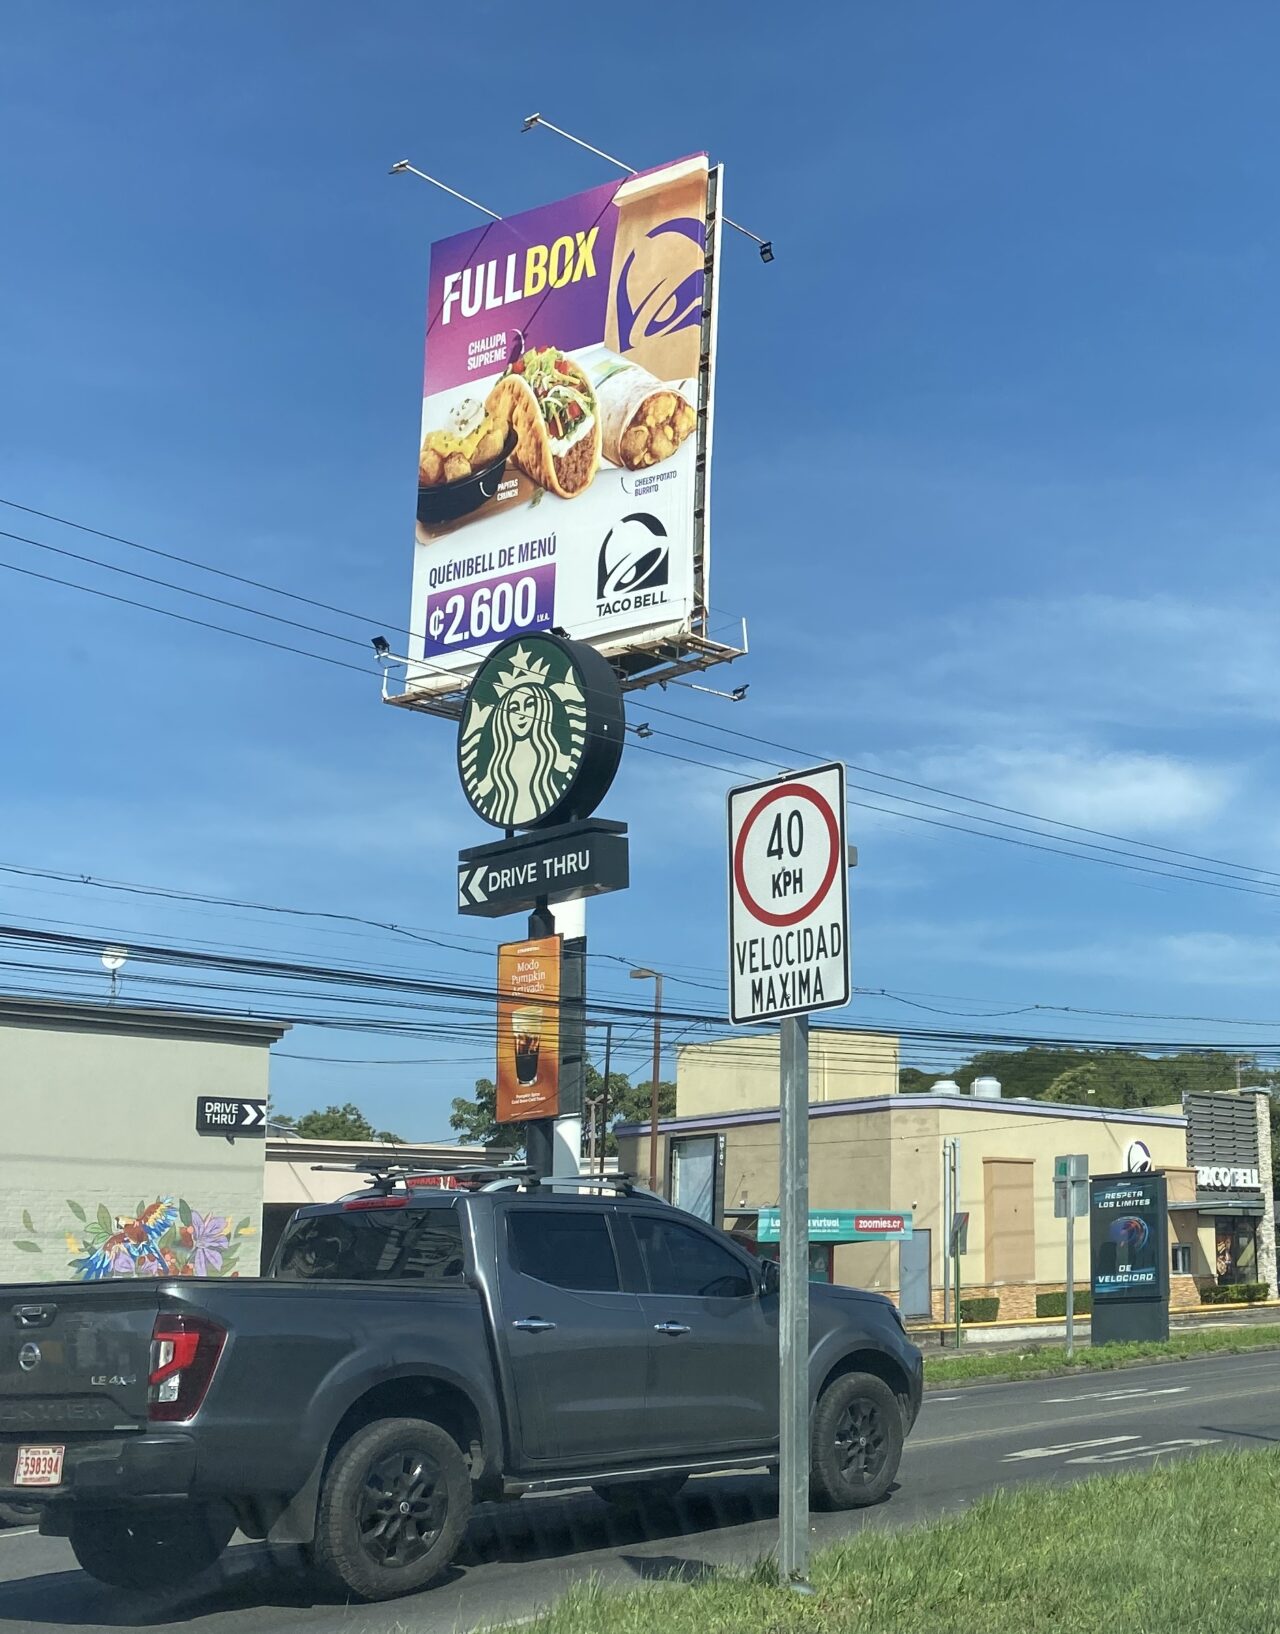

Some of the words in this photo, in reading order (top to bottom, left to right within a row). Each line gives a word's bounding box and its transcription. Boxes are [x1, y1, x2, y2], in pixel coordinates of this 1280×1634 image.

[468, 332, 506, 356] CHALUPA
[467, 347, 507, 371] SUPREME
[635, 475, 656, 488] CHEESY
[656, 470, 677, 482] POTATO
[634, 483, 659, 497] BURRITO
[429, 550, 495, 588] QUÉNIBELL
[498, 546, 515, 568] DE
[517, 532, 557, 563] MENÚ
[596, 596, 632, 618] TACO
[633, 590, 668, 610] BELL
[766, 809, 804, 860] 40
[488, 862, 537, 892] DRIVE
[543, 850, 591, 879] THRU
[771, 868, 803, 899] KPH
[736, 922, 841, 976] VELOCIDAD
[517, 958, 540, 973] Modo
[511, 970, 546, 986] Pumpkin
[751, 966, 825, 1014] MAXIMA
[205, 1102, 239, 1114] DRIVE
[204, 1113, 236, 1125] THRU
[1196, 1166, 1231, 1187] TACO
[1230, 1168, 1261, 1188] BELL
[1104, 1190, 1143, 1200] RESPETA
[1098, 1201, 1115, 1209] LOS
[812, 1216, 840, 1227] virtual
[858, 1218, 901, 1229] zoomies.cr
[1118, 1264, 1132, 1273] DE
[1098, 1273, 1154, 1283] VELOCIDAD
[91, 1375, 107, 1386] LE
[23, 1456, 60, 1476] 598394
